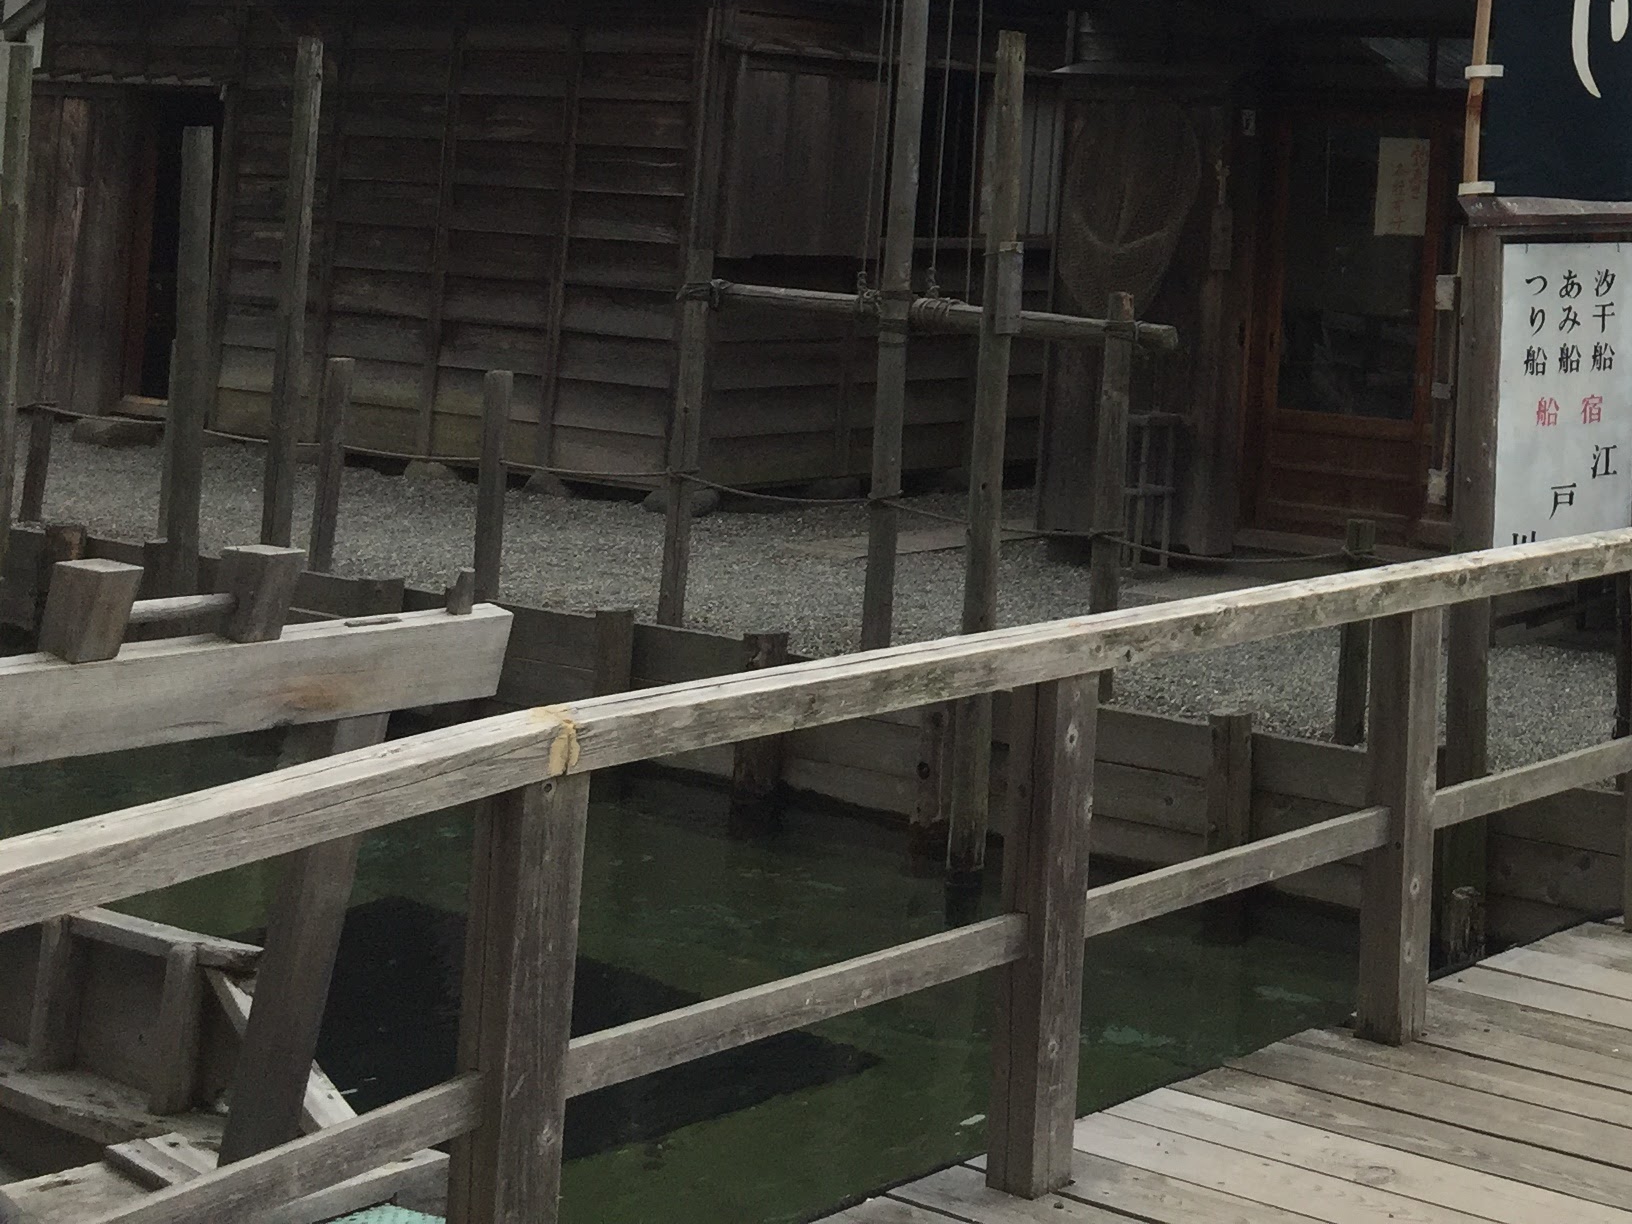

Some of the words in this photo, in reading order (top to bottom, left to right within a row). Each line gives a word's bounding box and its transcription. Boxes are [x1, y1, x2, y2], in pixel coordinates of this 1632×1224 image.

[1523, 275, 1548, 376] つり船
[1558, 269, 1582, 374] あみ船
[1590, 269, 1616, 373] 汐干船
[1535, 393, 1604, 427] 船宿
